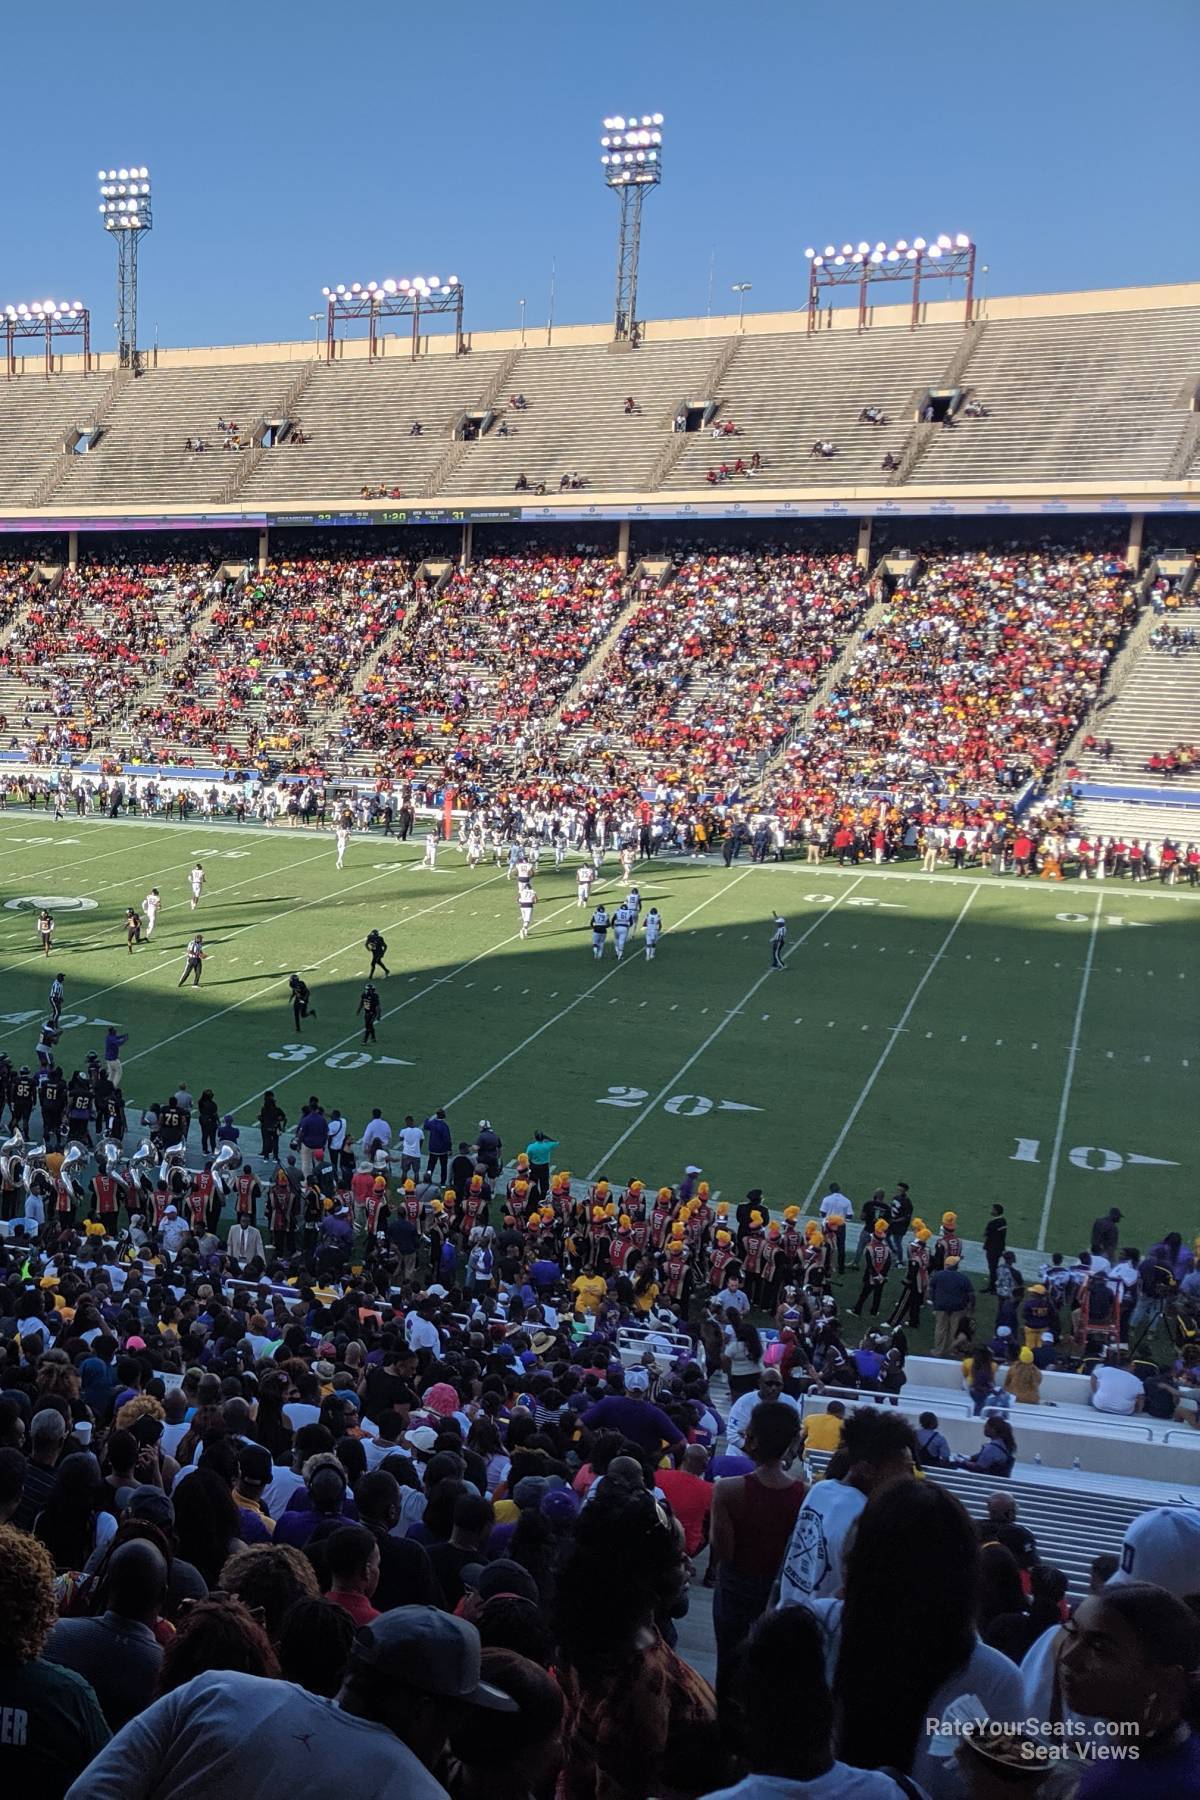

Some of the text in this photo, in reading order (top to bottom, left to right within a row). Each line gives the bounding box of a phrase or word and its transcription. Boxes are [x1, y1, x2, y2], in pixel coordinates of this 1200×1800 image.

[452, 511, 465, 521] 31
[267, 1044, 376, 1071] 30
[76, 1096, 89, 1109] 62
[595, 1085, 714, 1118] 20
[164, 1114, 179, 1126] 76
[1009, 1136, 1123, 1173] 10
